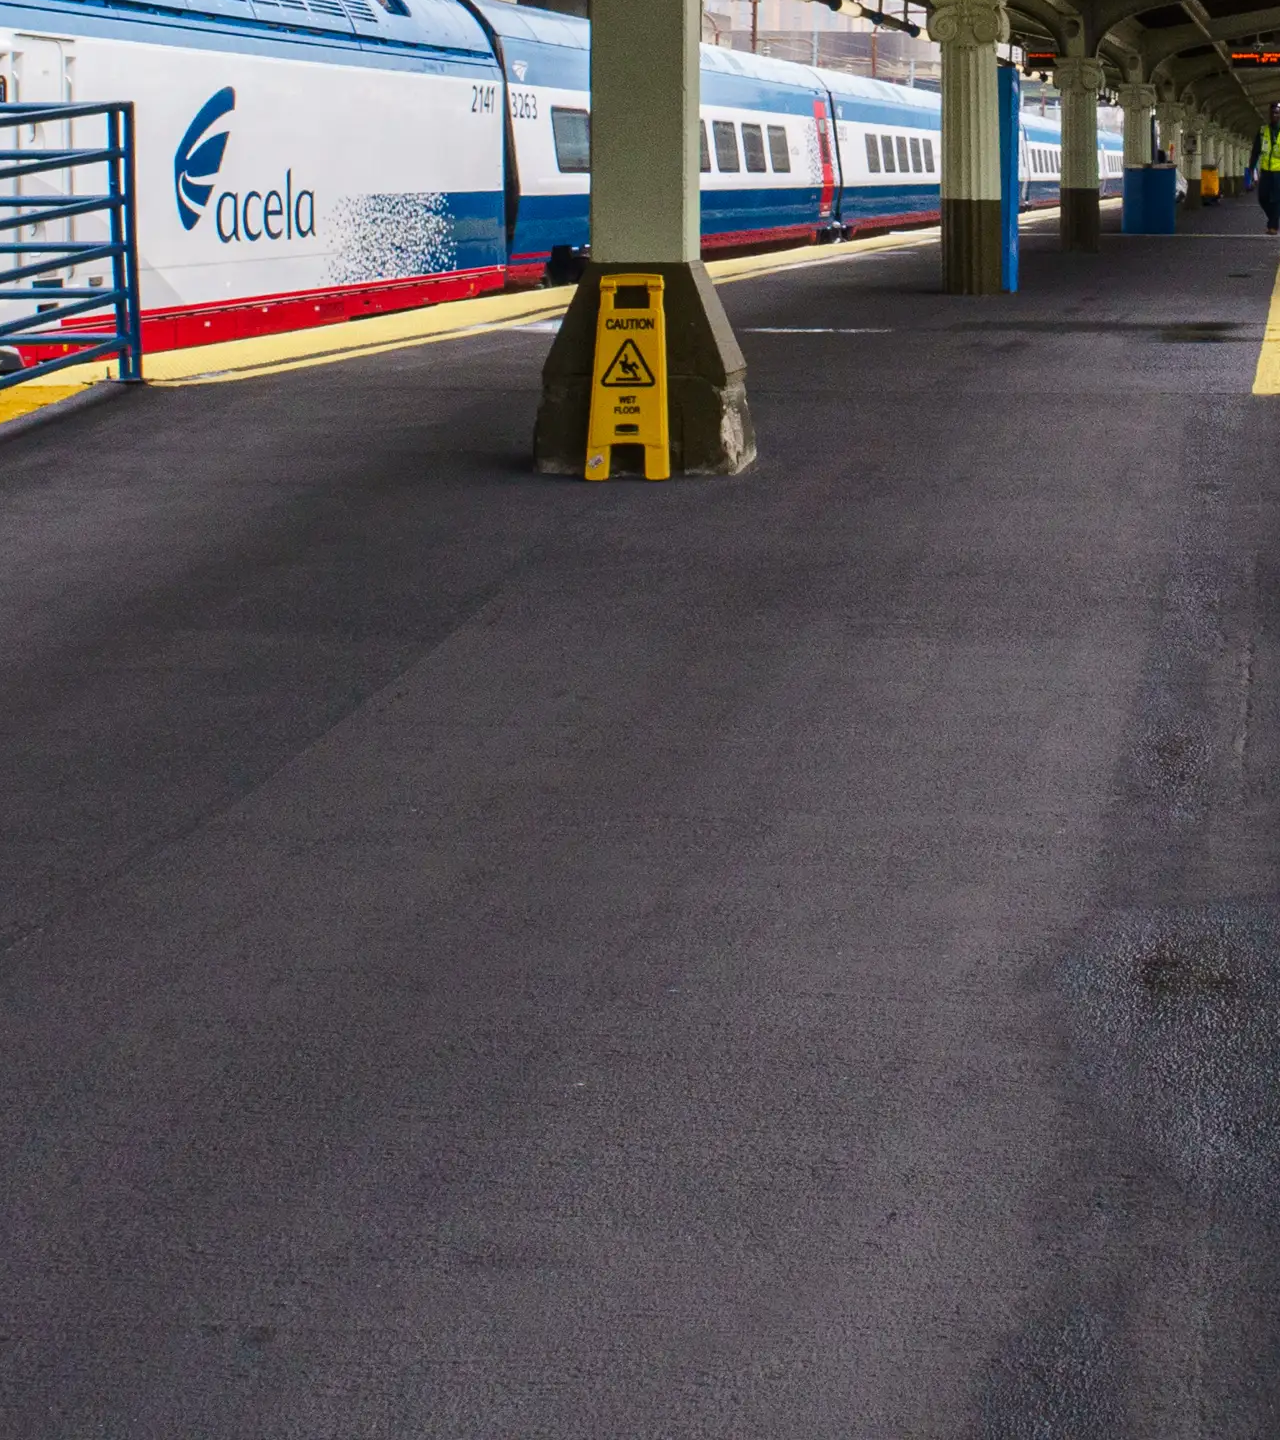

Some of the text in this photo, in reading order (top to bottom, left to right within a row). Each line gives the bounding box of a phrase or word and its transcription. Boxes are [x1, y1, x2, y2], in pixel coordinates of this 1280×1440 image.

[471, 85, 495, 113] 2141
[512, 92, 538, 119] 3263
[216, 168, 316, 244] acela
[605, 318, 655, 330] CAUTION
[619, 396, 637, 404] WET
